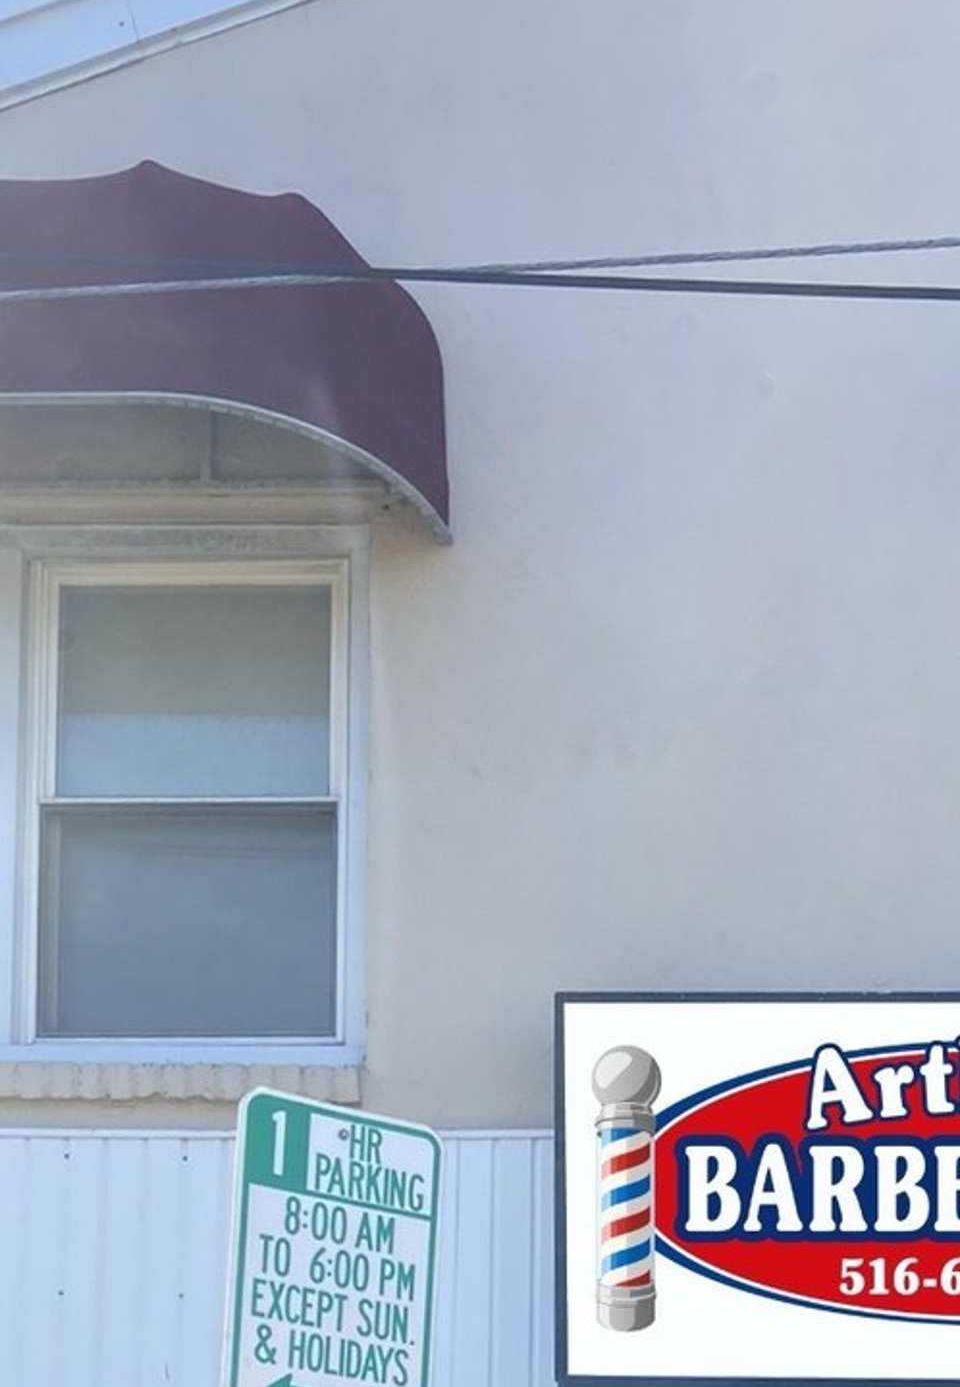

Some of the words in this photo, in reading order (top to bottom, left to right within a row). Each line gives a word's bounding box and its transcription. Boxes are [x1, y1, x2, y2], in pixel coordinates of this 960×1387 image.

[270, 1110, 288, 1176] 1
[347, 1124, 383, 1165] HR
[314, 1153, 425, 1212] PARKING
[284, 1195, 349, 1246] 8:00
[355, 1211, 396, 1256] AM
[259, 1233, 292, 1278] TO
[308, 1246, 370, 1293] 6:00
[378, 1257, 416, 1303] PM
[250, 1276, 349, 1333] EXCEPT
[356, 1297, 416, 1347] SUN.
[253, 1323, 278, 1367] &
